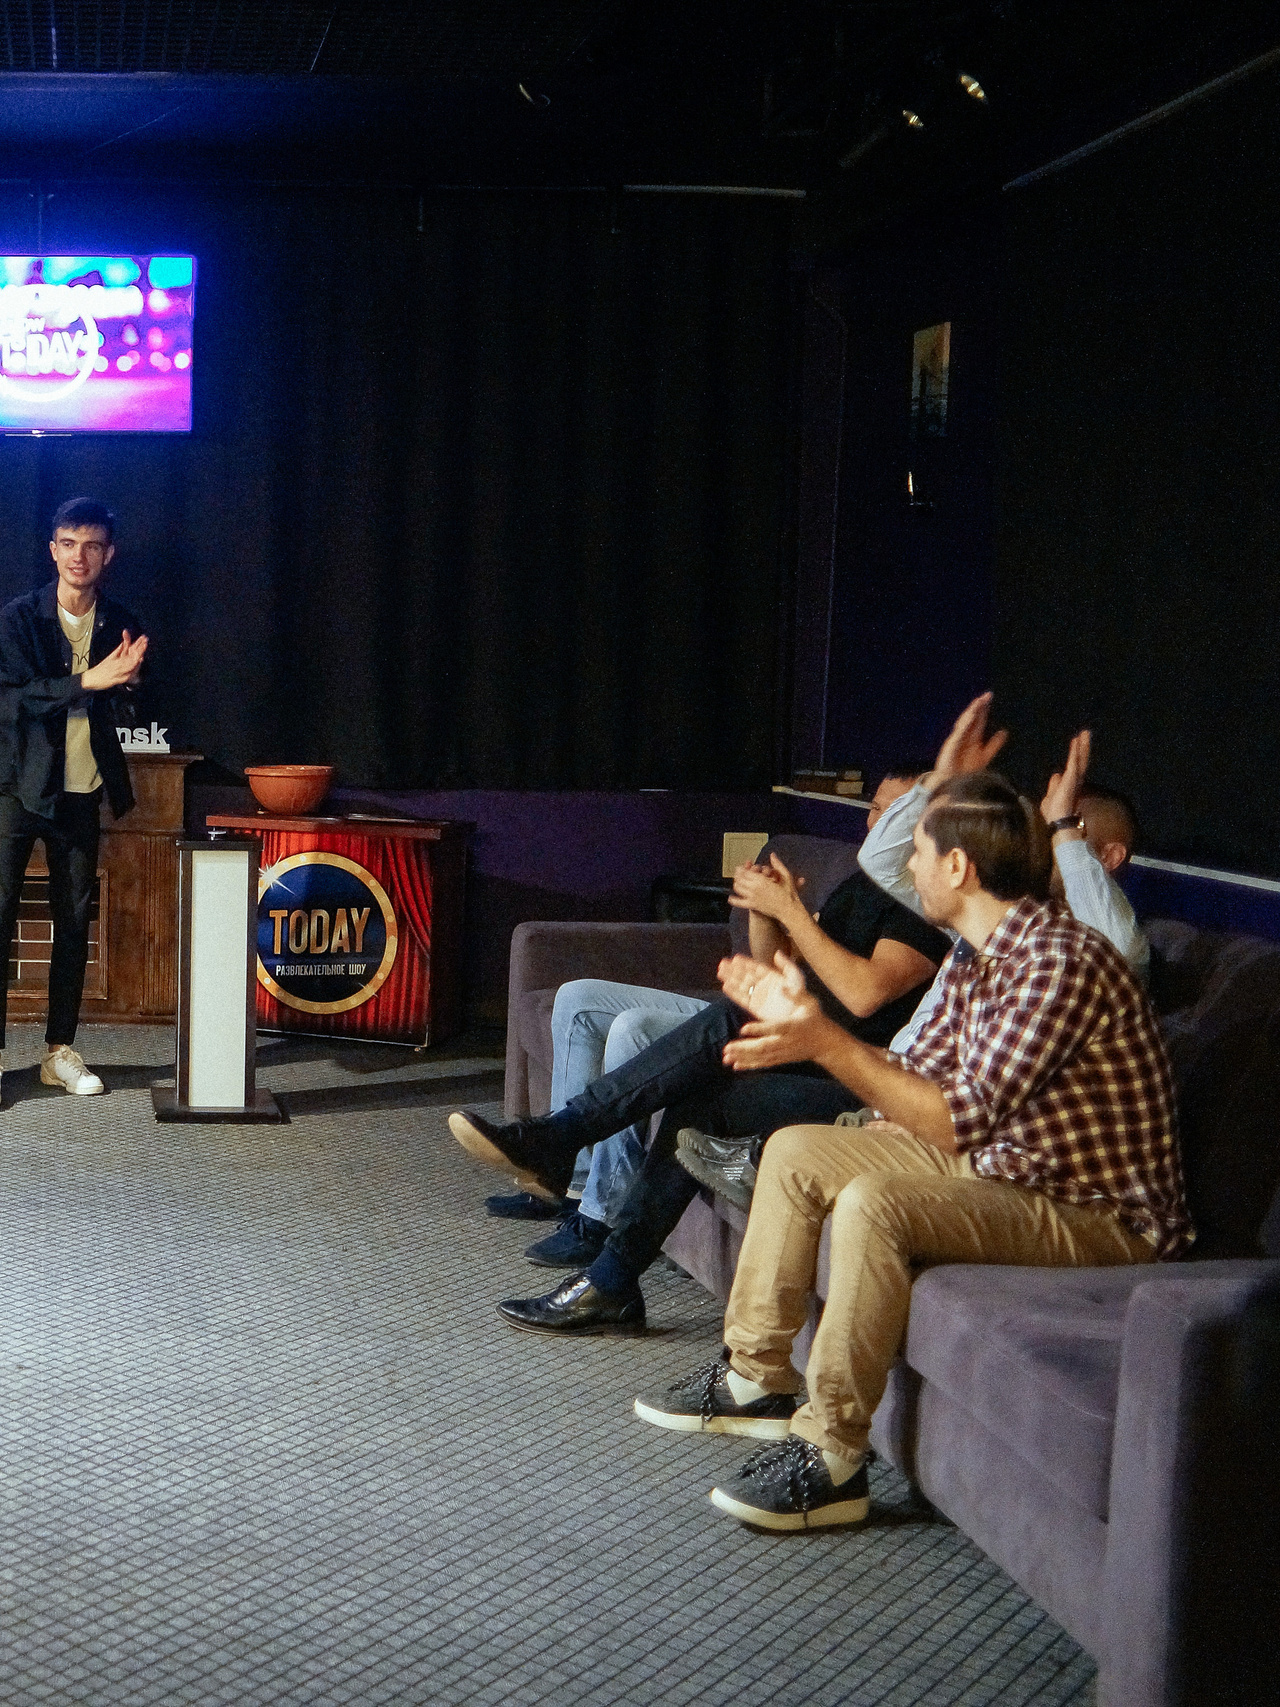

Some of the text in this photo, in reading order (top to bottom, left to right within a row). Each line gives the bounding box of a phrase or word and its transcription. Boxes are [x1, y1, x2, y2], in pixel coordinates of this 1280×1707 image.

[0, 330, 85, 369] TDAY
[268, 907, 371, 955] TODAY
[275, 963, 367, 976] РАЗВЛЕКАТЕЛЬНОЕ ШОУ
